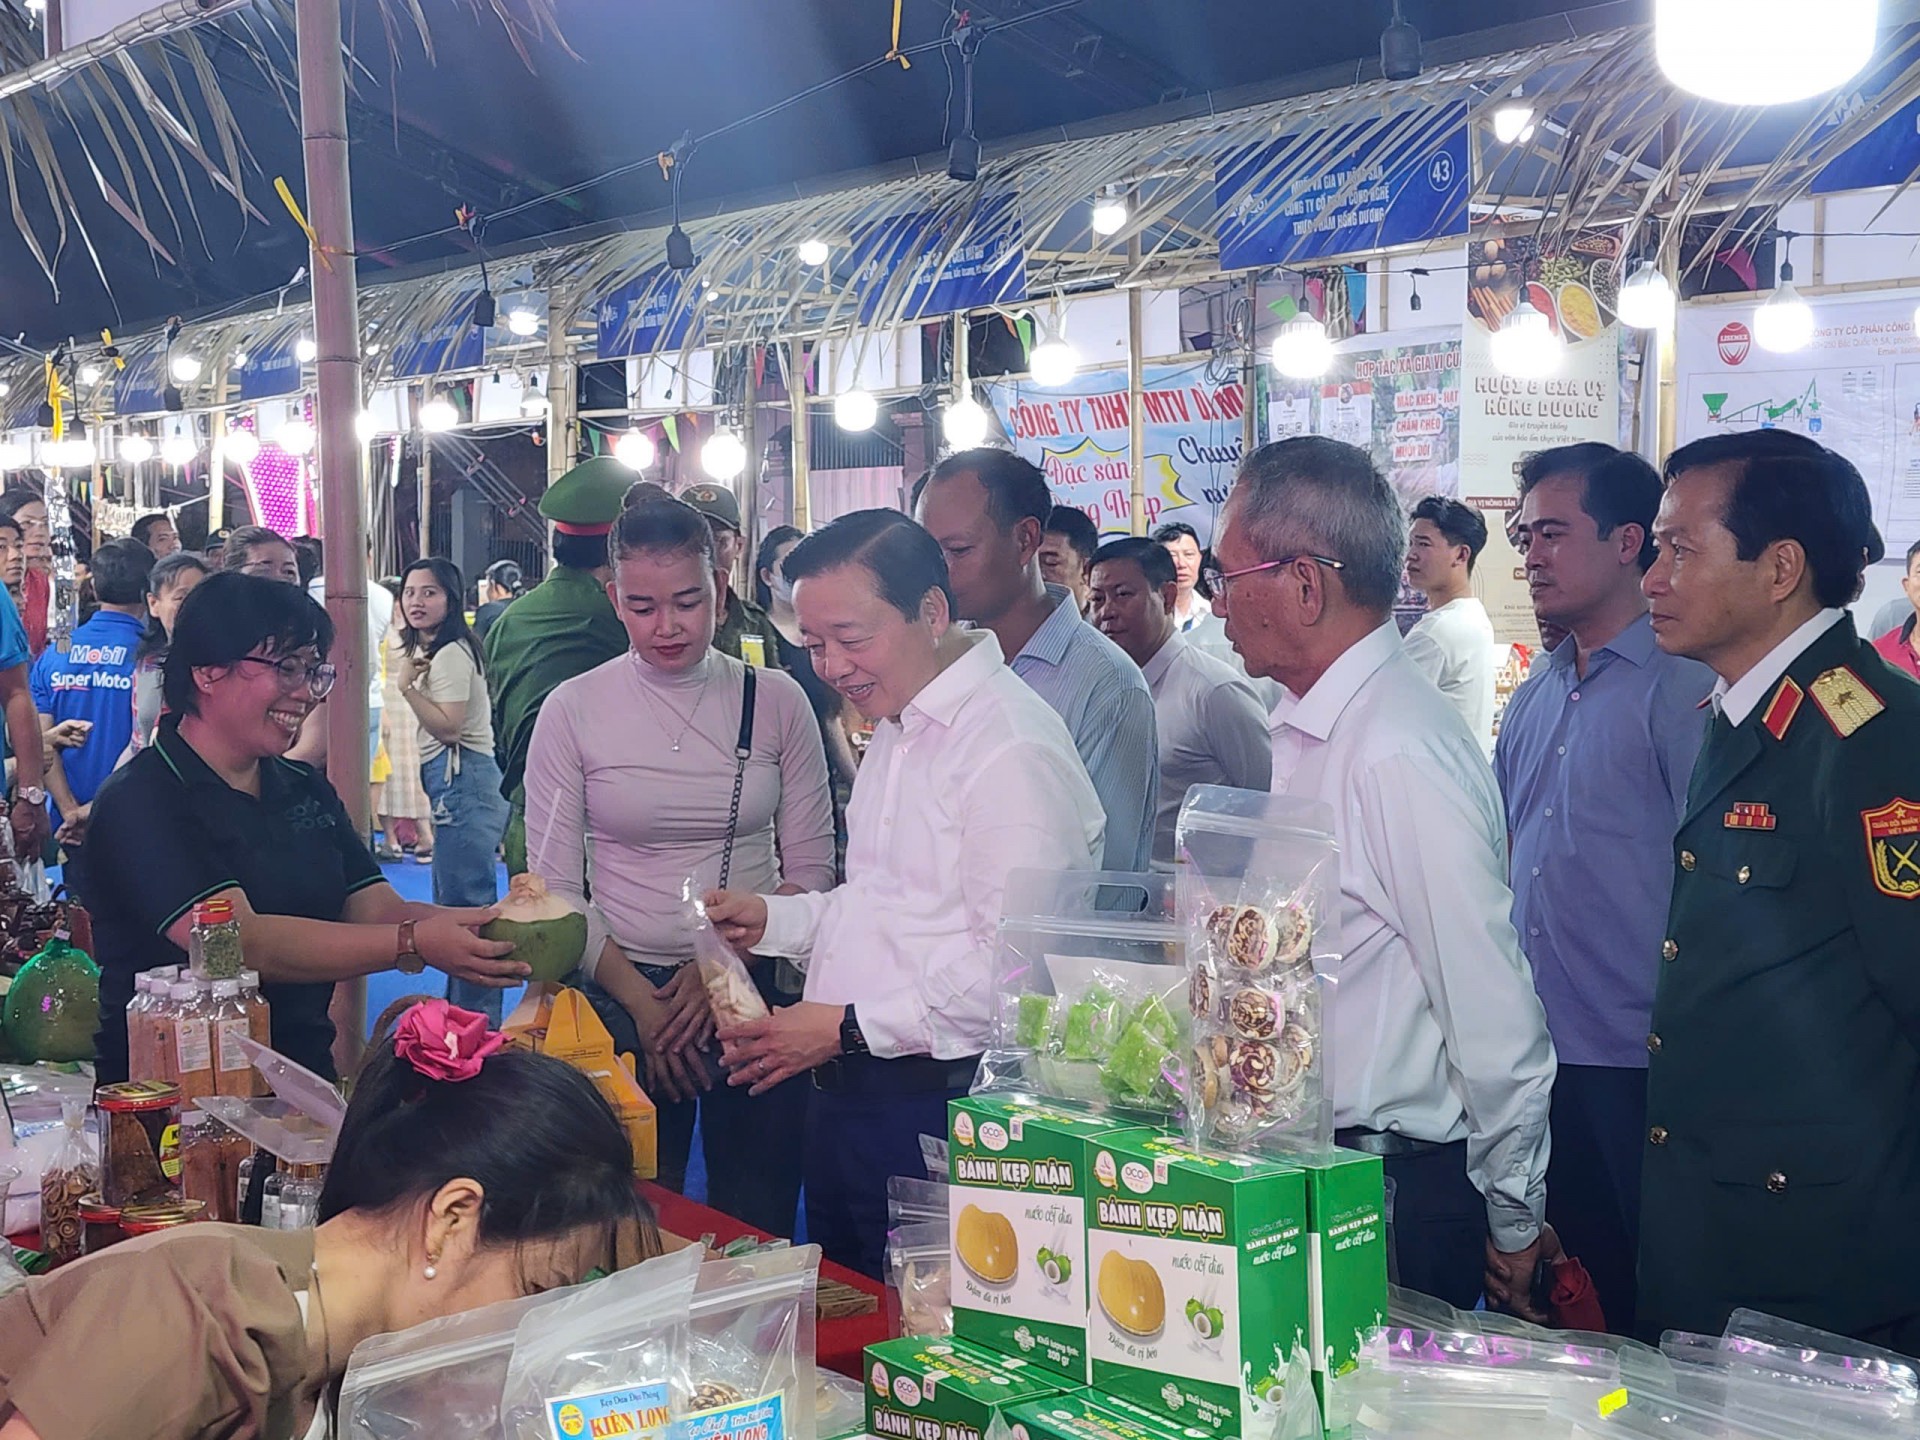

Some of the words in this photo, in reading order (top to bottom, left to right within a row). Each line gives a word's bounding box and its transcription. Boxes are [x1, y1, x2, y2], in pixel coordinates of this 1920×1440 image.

[1432, 159, 1450, 182] 43
[1415, 356, 1432, 371] GIA
[1545, 380, 1578, 396] GIA
[1009, 398, 1060, 439] CÔNG
[1058, 398, 1084, 433] TY
[1143, 389, 1190, 423] MTV
[1045, 456, 1089, 490] Đặc
[1093, 456, 1130, 481] sản
[1104, 489, 1161, 524] Thp
[69, 644, 127, 665] Mobil
[50, 672, 90, 690] Super
[92, 671, 131, 689] Moto
[957, 1156, 997, 1181] BÁNH
[1001, 1162, 1031, 1188] KẸP
[1125, 1167, 1149, 1179] OCOP
[1099, 1198, 1142, 1226] BÁNH
[1145, 1206, 1178, 1234] KẸP
[1182, 1207, 1223, 1238] MẶN
[590, 1409, 635, 1438] KIÊN
[874, 1408, 911, 1437] BÁNH
